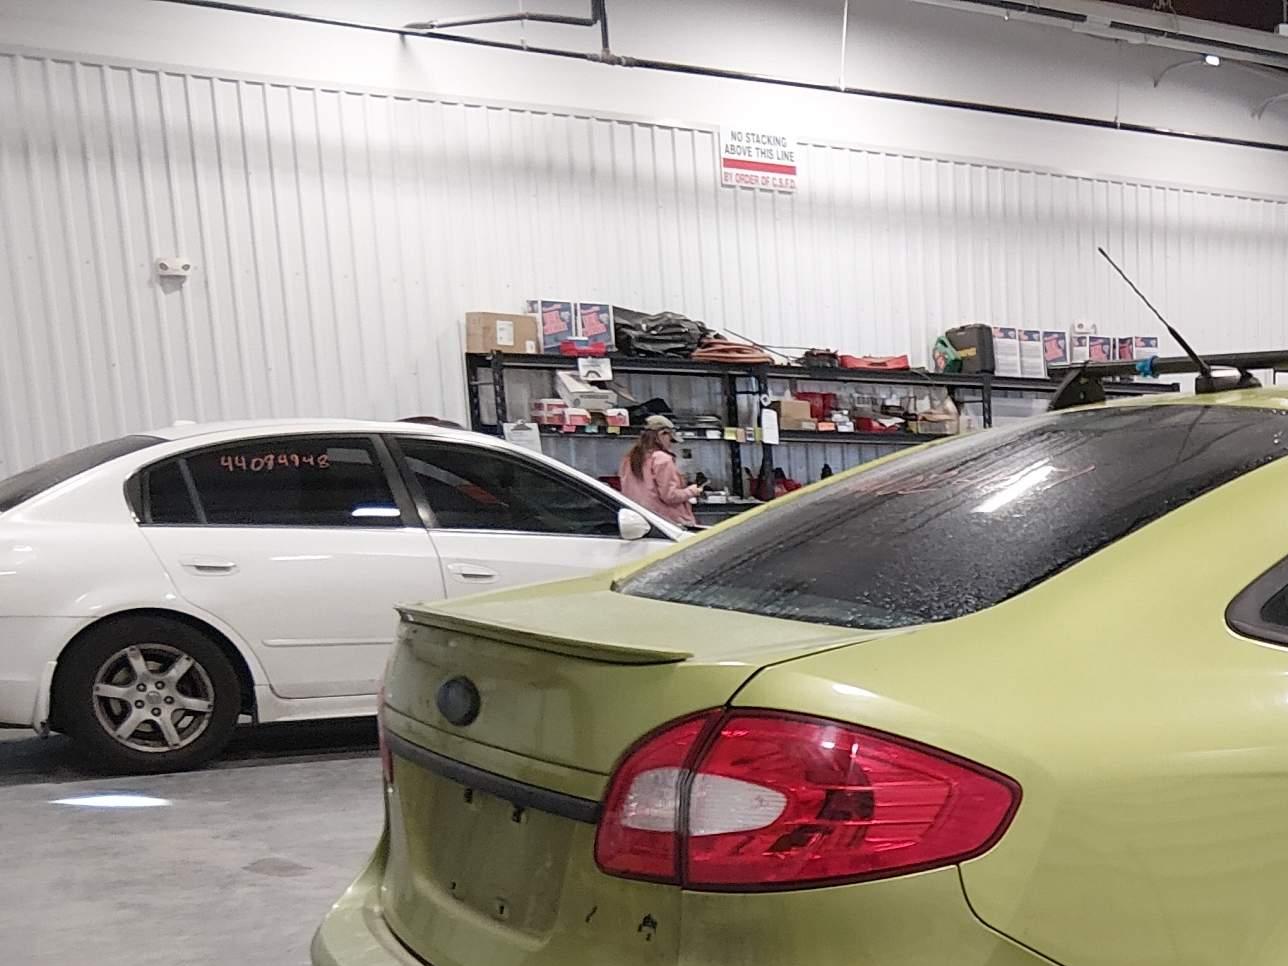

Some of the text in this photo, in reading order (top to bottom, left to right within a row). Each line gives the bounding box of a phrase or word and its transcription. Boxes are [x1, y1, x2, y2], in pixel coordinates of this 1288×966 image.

[730, 130, 787, 148] NO STACKING
[724, 144, 795, 162] ABOVE THIS LINE
[735, 173, 759, 185] ORDER
[761, 176, 770, 186] OF
